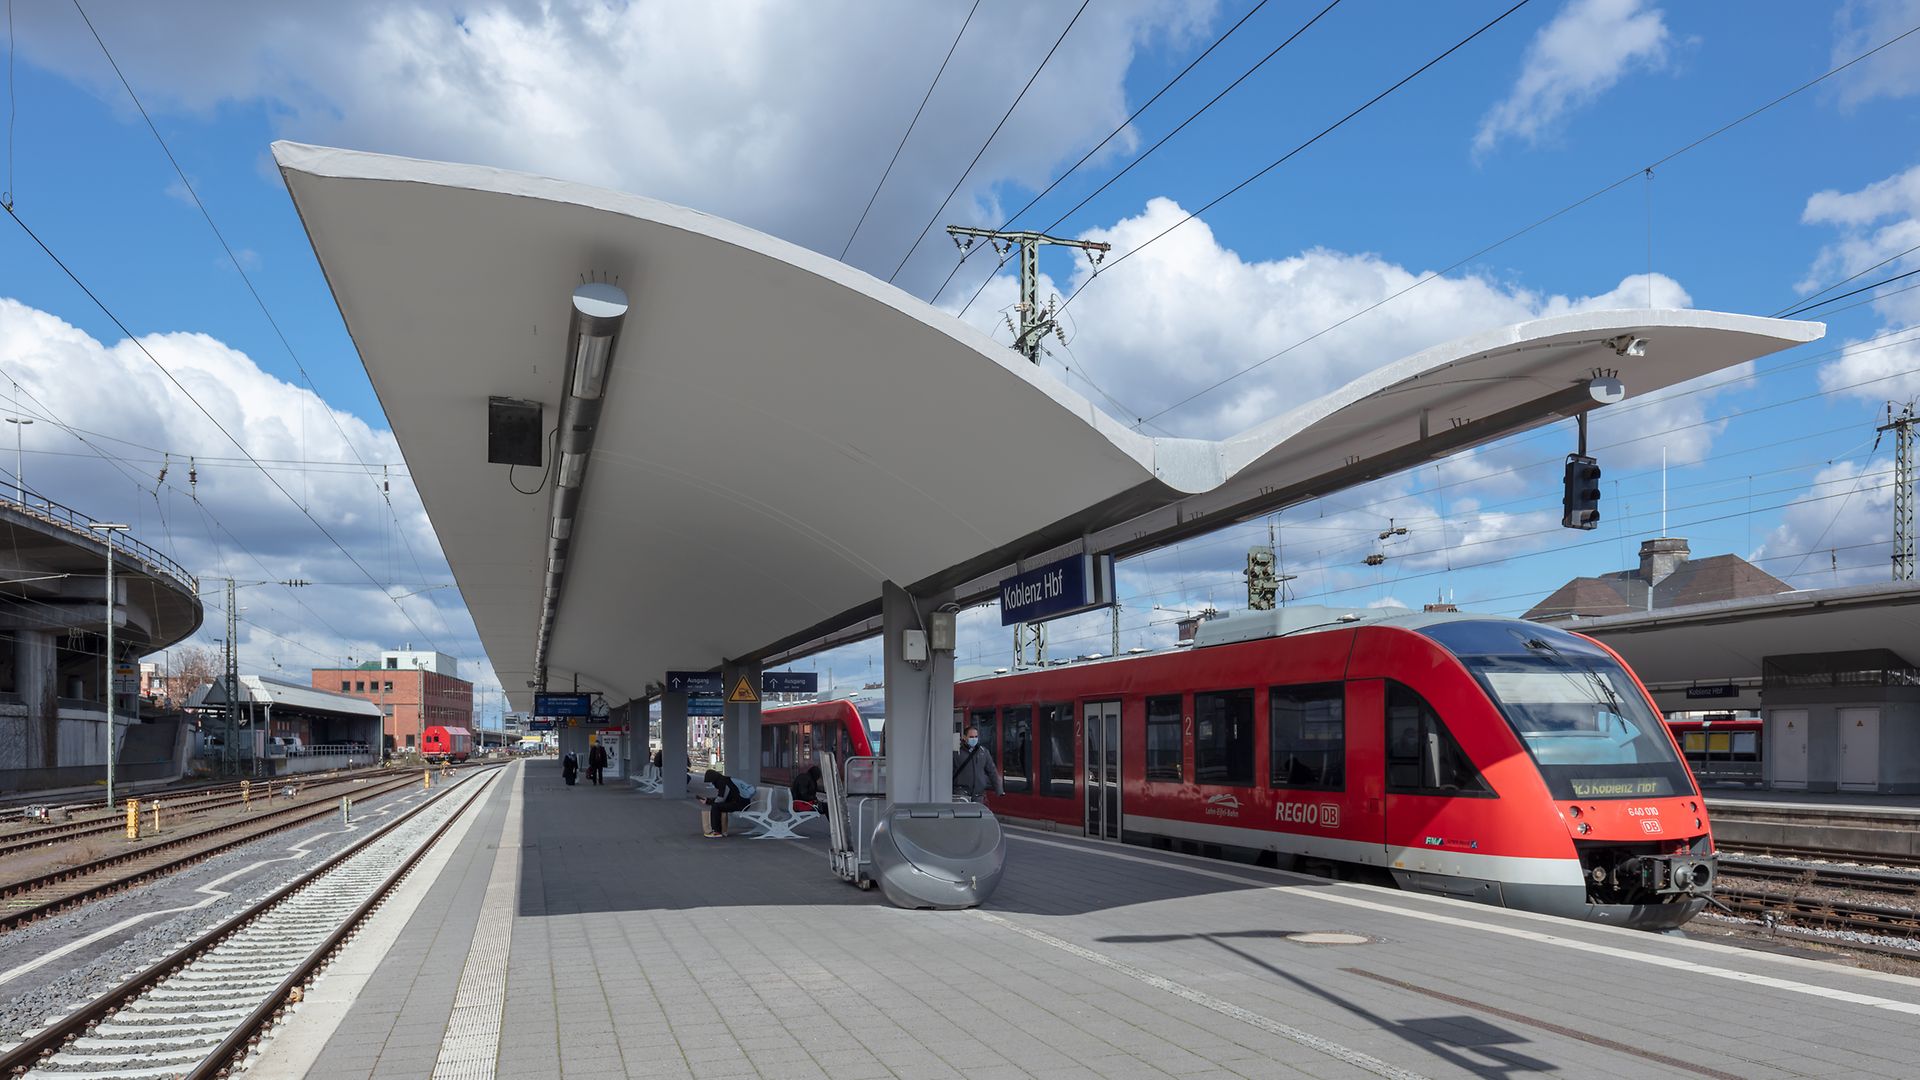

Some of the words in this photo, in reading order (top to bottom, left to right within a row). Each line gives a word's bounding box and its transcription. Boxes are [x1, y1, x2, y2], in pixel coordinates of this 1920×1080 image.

[1004, 581, 1042, 610] Koblenz
[1043, 568, 1063, 598] Hbf
[687, 677, 709, 685] Ausgang
[1076, 721, 1081, 737] 2
[1185, 716, 1192, 735] 2
[1275, 801, 1318, 824] REGIO
[1322, 805, 1338, 826] DB
[1628, 807, 1644, 817] 640
[1645, 806, 1659, 816] 010
[1642, 820, 1661, 833] DB
